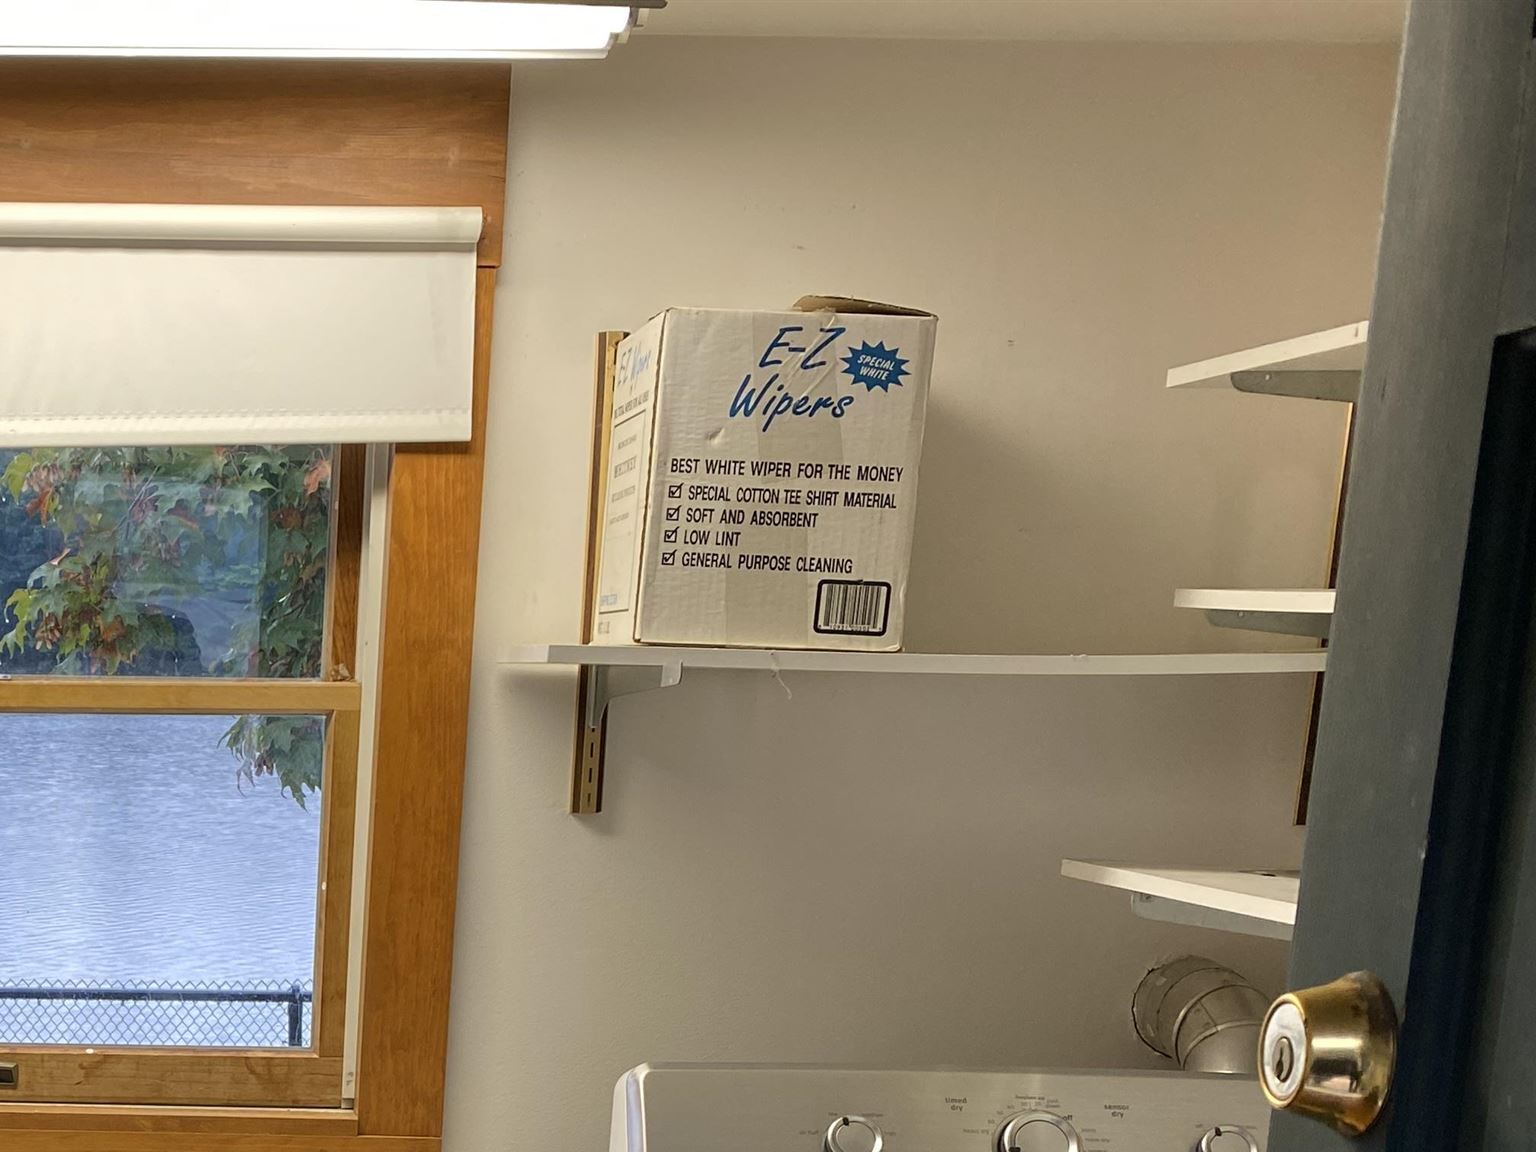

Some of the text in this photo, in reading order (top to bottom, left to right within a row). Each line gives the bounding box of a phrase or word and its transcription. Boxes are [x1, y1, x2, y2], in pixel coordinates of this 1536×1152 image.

[759, 326, 846, 370] E-Z
[857, 354, 896, 370] SPECIAL
[859, 366, 890, 381] WHITE
[729, 373, 854, 433] Wipers
[670, 458, 904, 482] BEST WHITE WIPER FOR THE MONEY
[688, 485, 897, 509] SPECIAL COTTON TEE SHIRT MATERIAL
[686, 507, 819, 528] SOFT AND ABSORBENT
[683, 529, 742, 546] LOW LINT
[681, 552, 853, 574] GENERAL PURPOSE CLEANING
[950, 1104, 964, 1112] dry
[1104, 1103, 1130, 1111] sensor
[1111, 1110, 1125, 1119] dry
